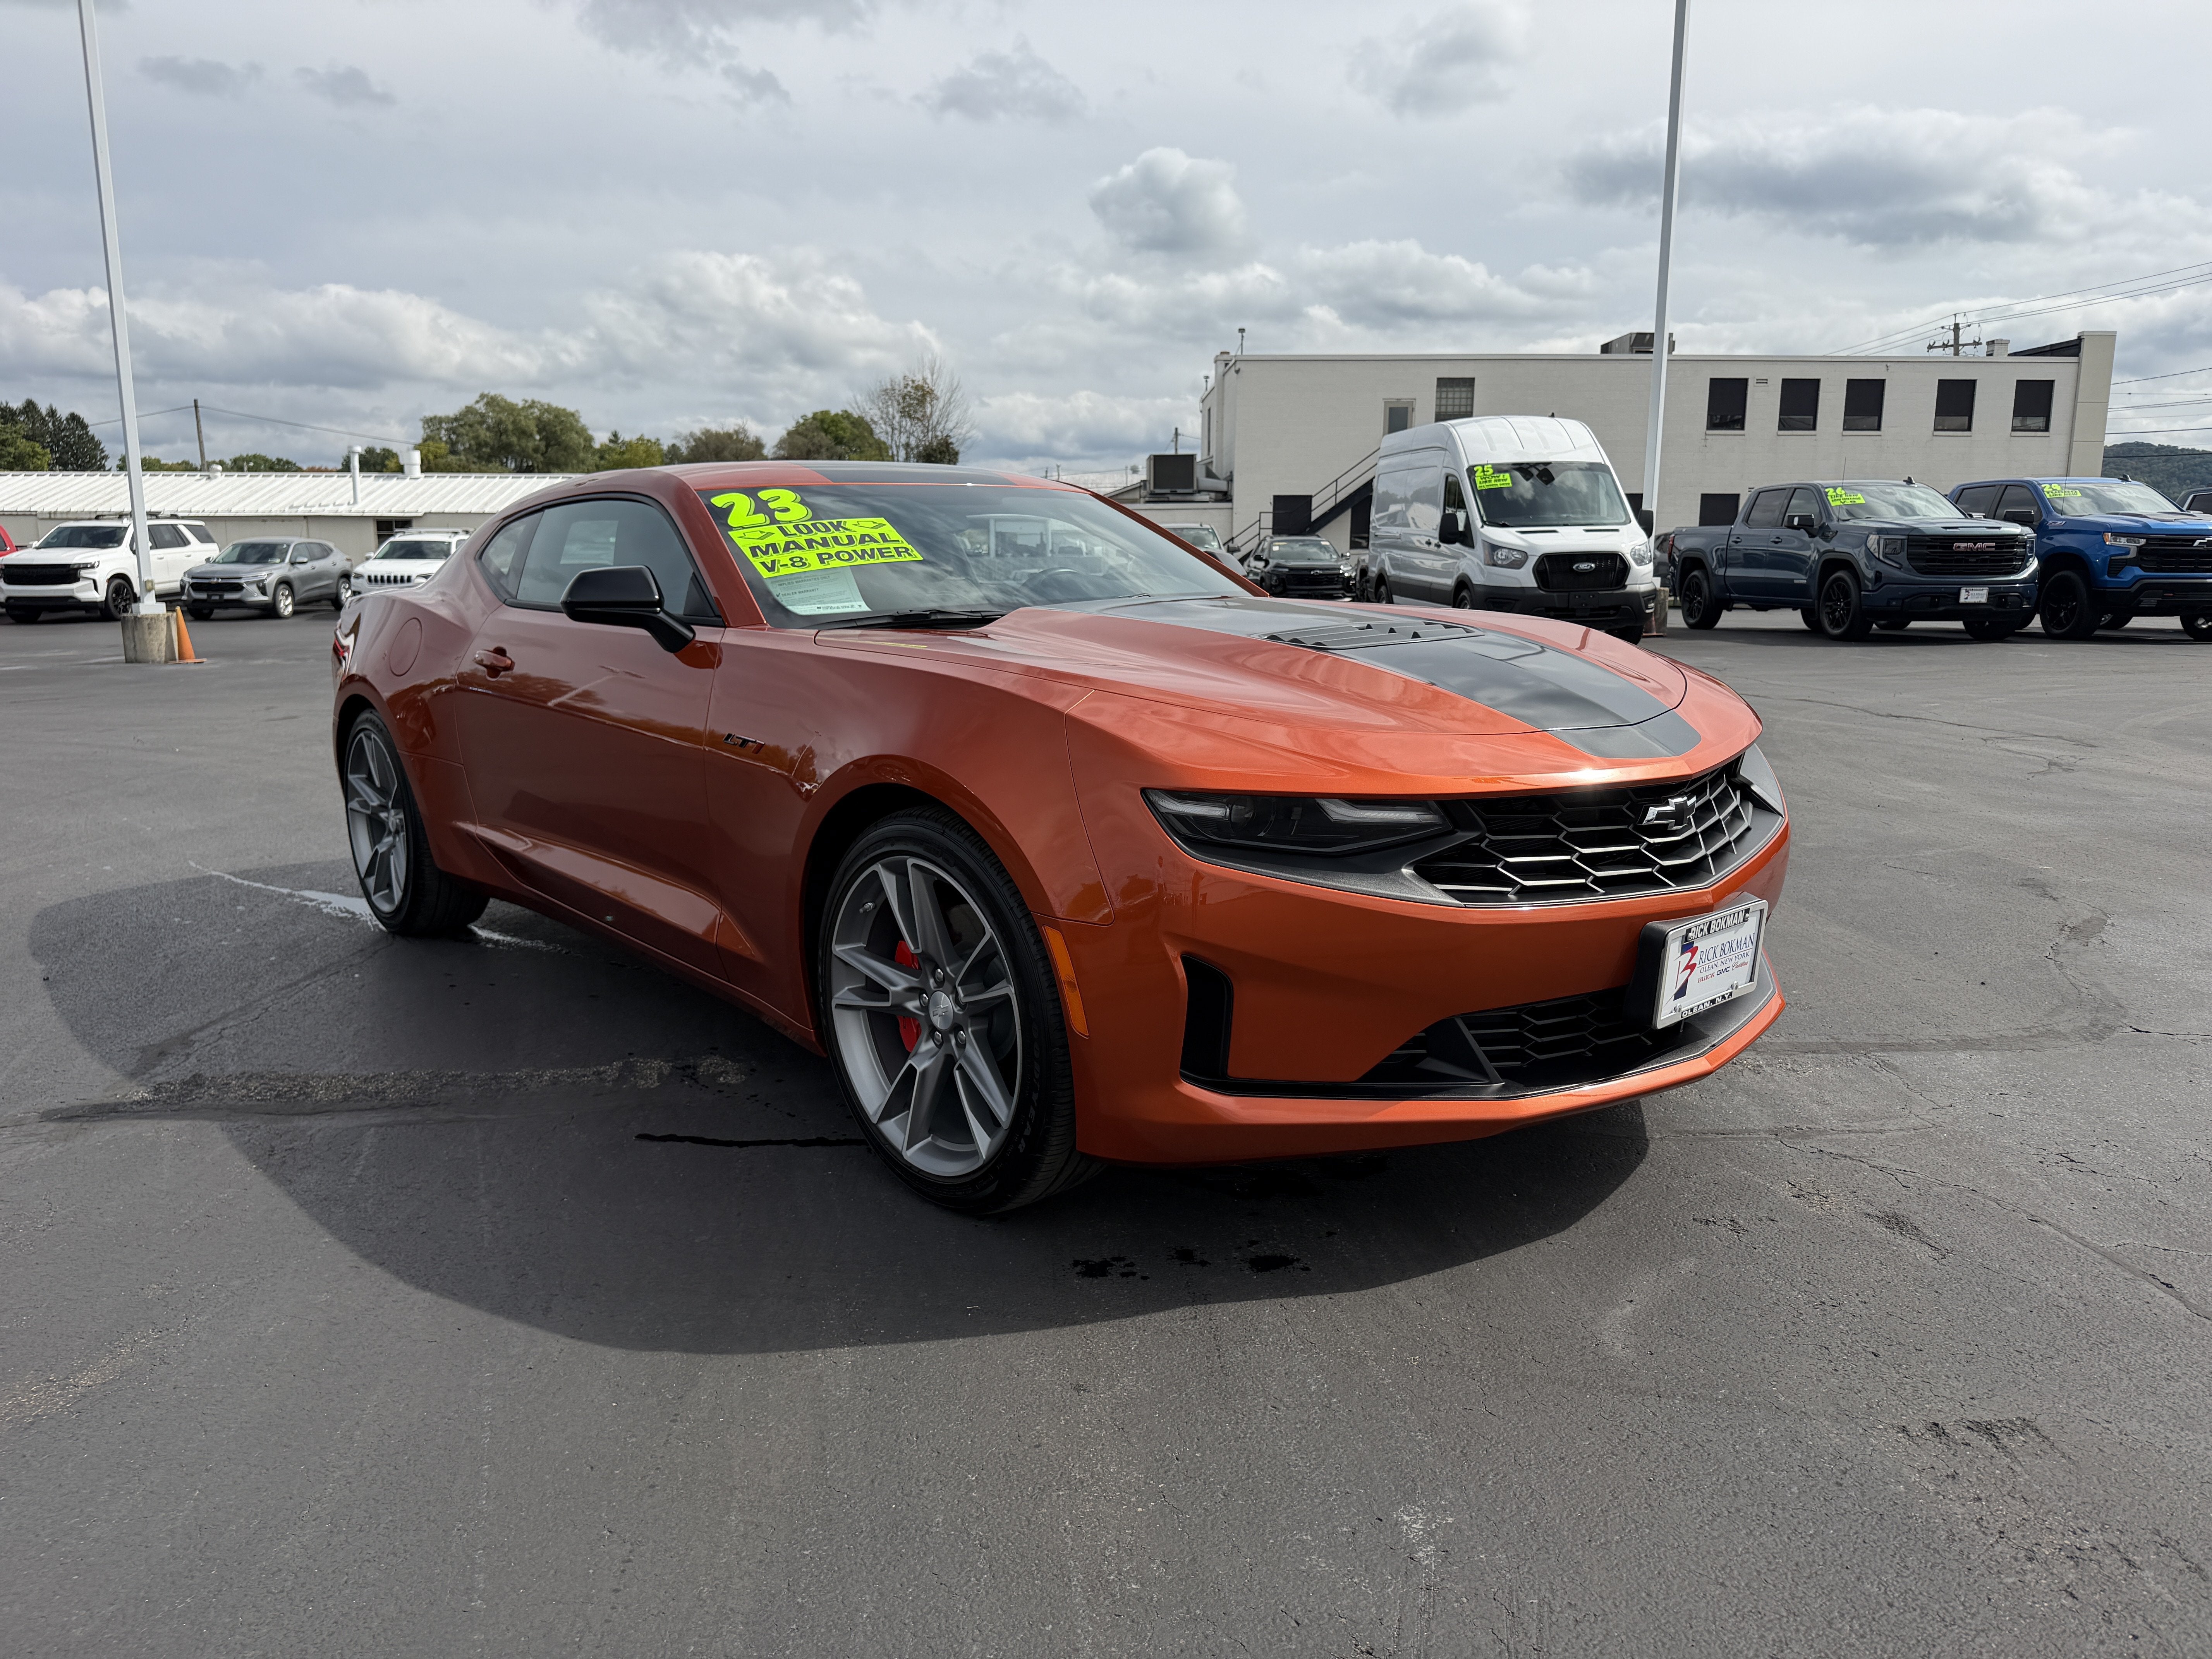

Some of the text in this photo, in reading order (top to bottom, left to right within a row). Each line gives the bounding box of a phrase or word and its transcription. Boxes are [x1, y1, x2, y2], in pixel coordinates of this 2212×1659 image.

[1474, 465, 1493, 476] 25
[1825, 487, 1845, 496] 26
[711, 489, 812, 528] 23
[776, 520, 854, 538] LOOK
[749, 533, 902, 558] MANUAL
[1953, 543, 1996, 551] GMC
[759, 546, 916, 573] V-8 POWER
[1691, 910, 1745, 939] RICK BOKMAN
[1698, 933, 1755, 965] RICK BOKMAN
[1720, 956, 1733, 966] NEW
[1735, 951, 1750, 961] YORK
[1697, 972, 1715, 983] BUICK
[1716, 966, 1730, 975] GMC
[1682, 993, 1731, 1017] OLEAN, N.Y.
[1018, 1000, 1041, 1153] GOODYEAR
